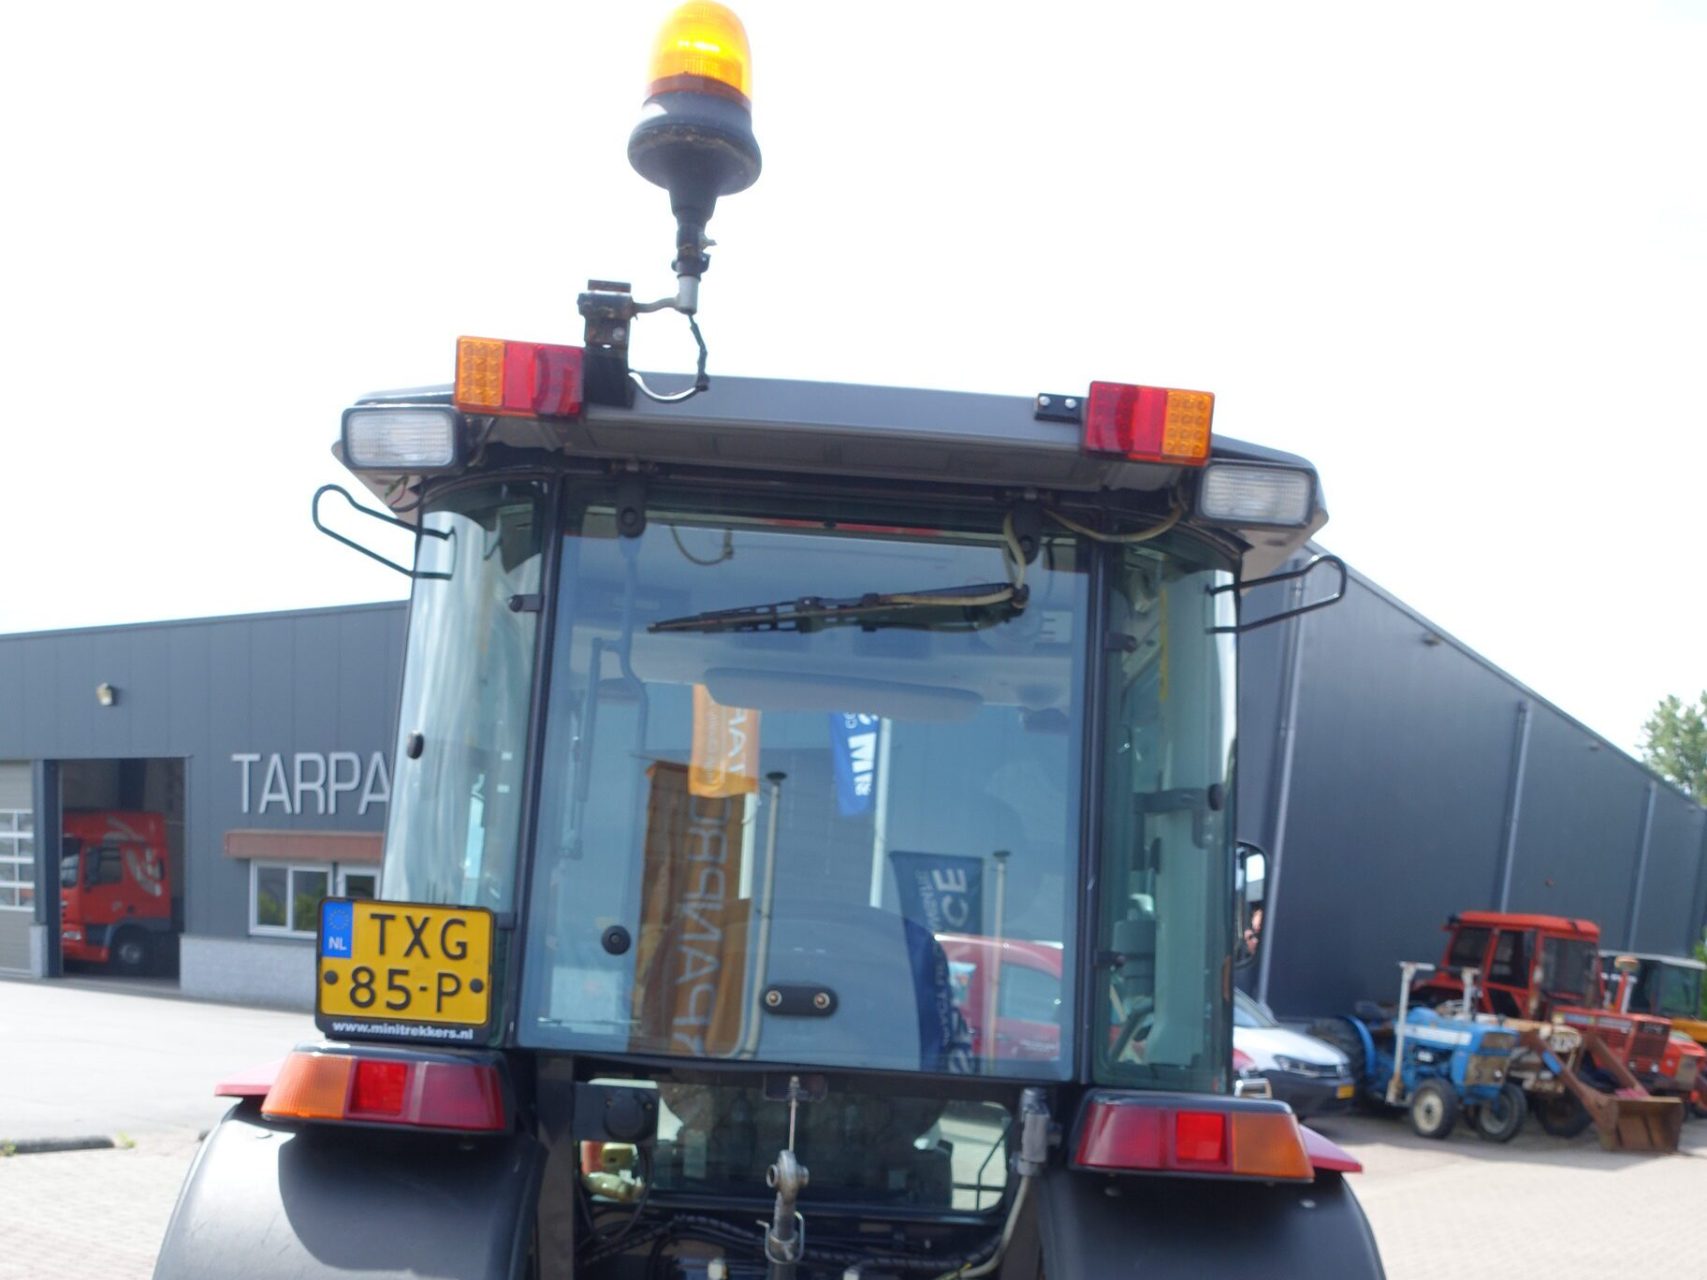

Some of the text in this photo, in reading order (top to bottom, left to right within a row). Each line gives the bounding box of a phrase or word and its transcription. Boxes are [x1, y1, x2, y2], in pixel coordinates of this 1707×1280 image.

[231, 751, 391, 815] TARPA
[328, 936, 347, 951] NL
[370, 913, 468, 960] TXG
[350, 966, 461, 1013] 85-P
[332, 1021, 474, 1040] www.minitrekkers.nl
